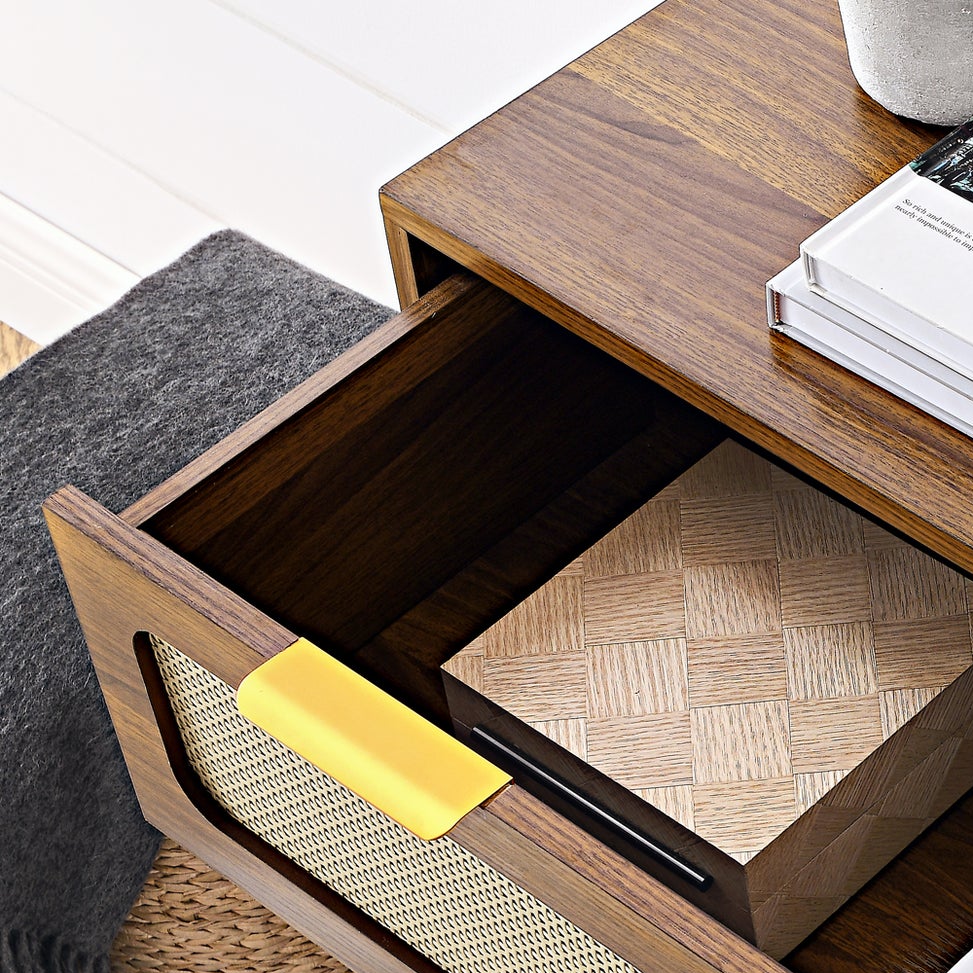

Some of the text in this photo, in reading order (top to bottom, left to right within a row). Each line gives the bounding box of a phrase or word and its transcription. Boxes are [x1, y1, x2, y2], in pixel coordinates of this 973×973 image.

[895, 204, 917, 219] nearly
[916, 216, 953, 239] impossible
[902, 199, 912, 207] So
[912, 204, 927, 215] rich
[926, 213, 942, 222] and
[940, 220, 965, 235] unique
[964, 231, 972, 239] is
